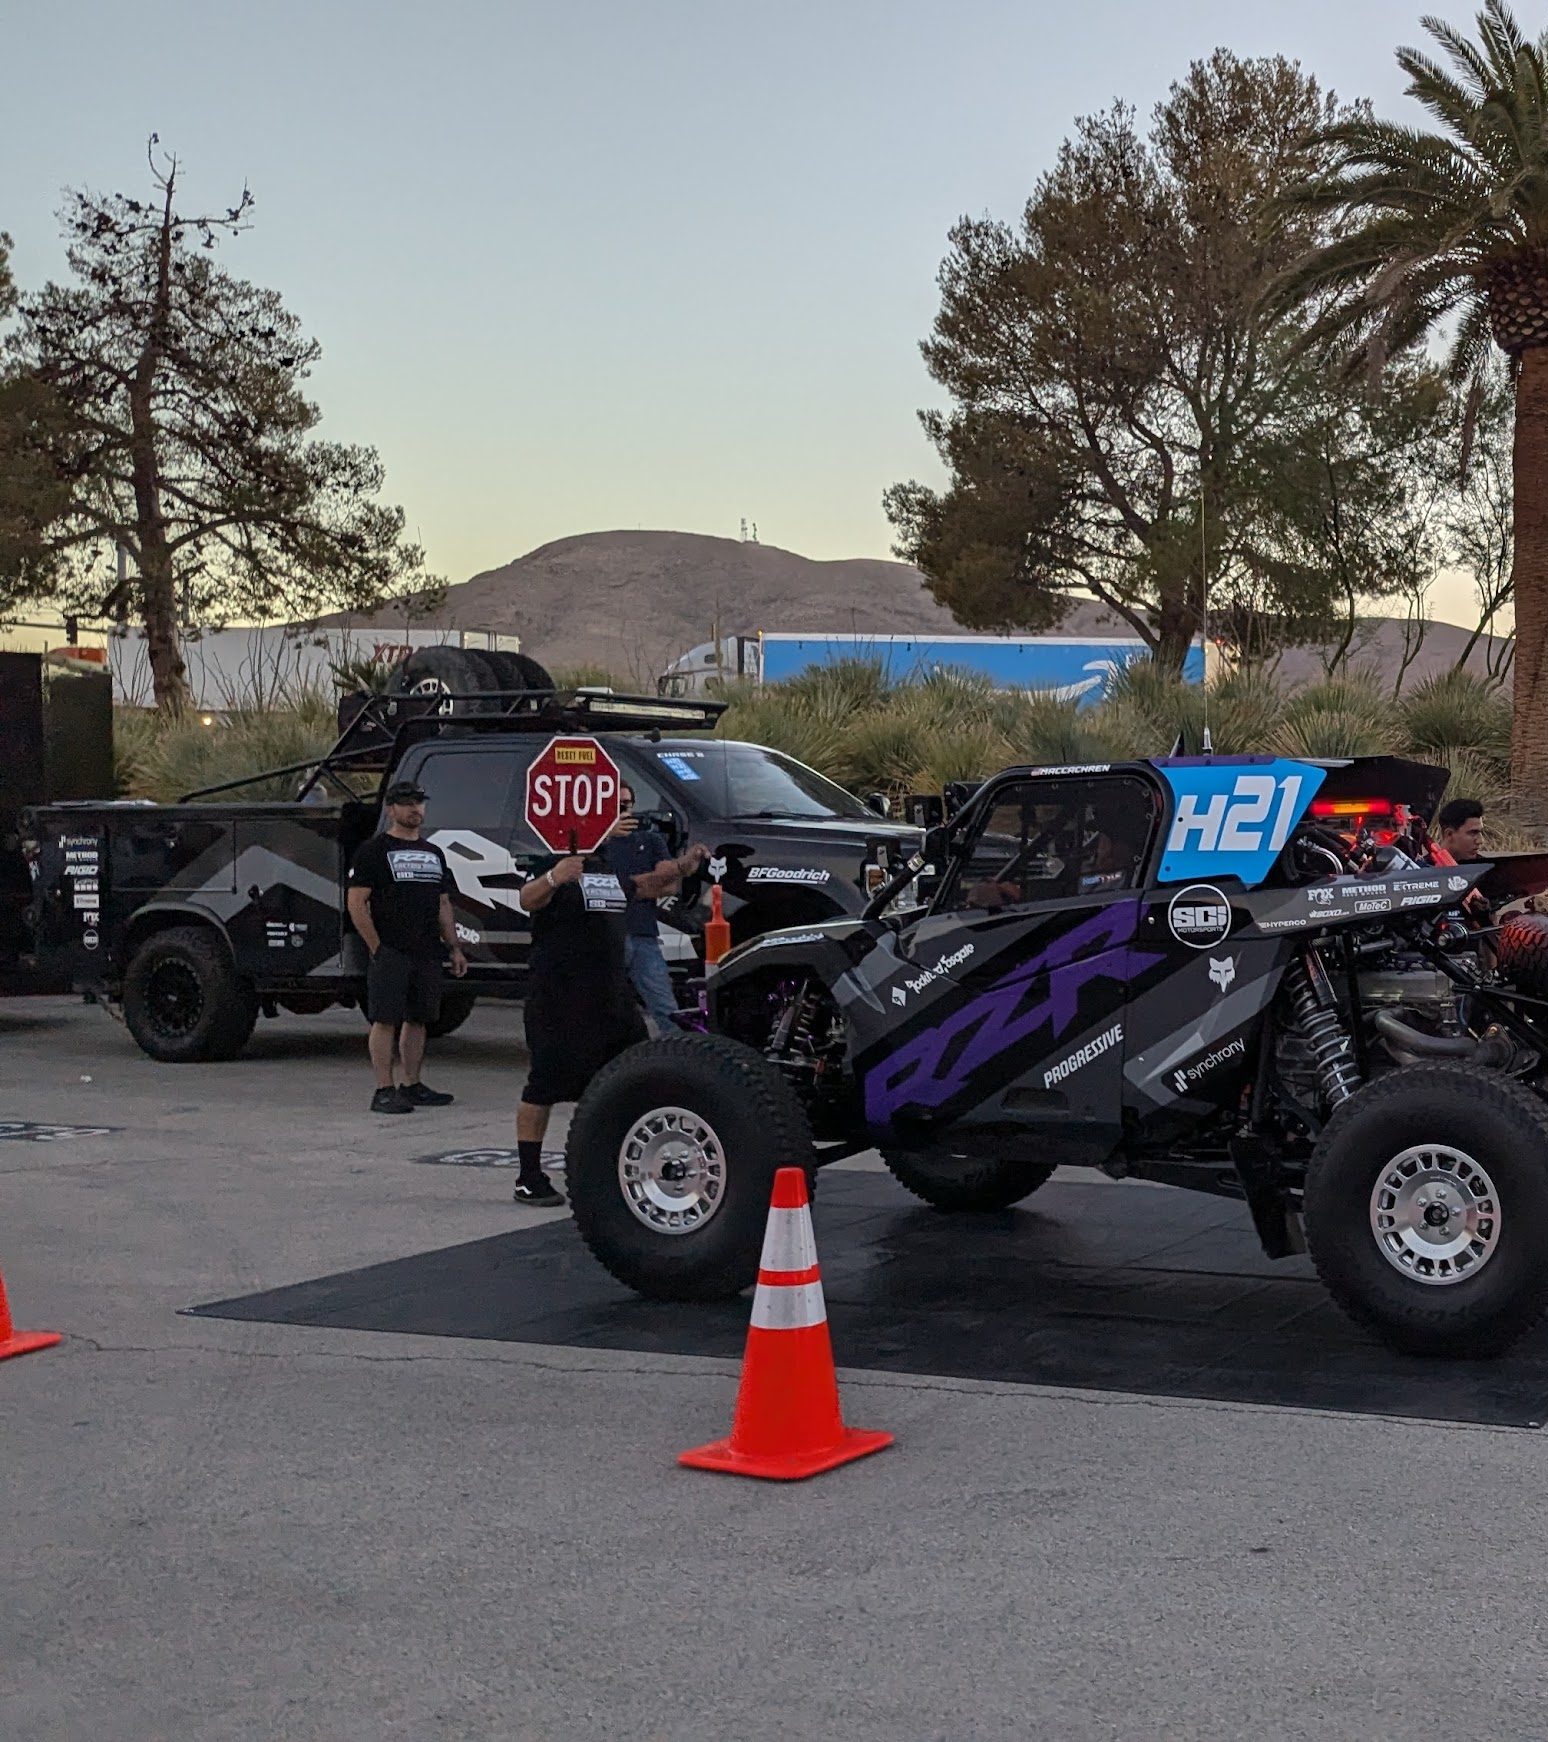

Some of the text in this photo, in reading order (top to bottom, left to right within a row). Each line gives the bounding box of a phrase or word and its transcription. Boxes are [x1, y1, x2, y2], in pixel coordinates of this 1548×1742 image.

[579, 751, 594, 760] FUEL
[532, 774, 615, 817] STOP
[1168, 775, 1303, 851] H21
[748, 867, 830, 881] BFGoodrich
[1307, 887, 1335, 905] FOX
[1342, 885, 1386, 894] METHOD
[1359, 901, 1388, 911] MoTeC
[1401, 895, 1442, 906] RIGID
[864, 899, 1168, 1124] RZR
[1044, 1024, 1124, 1089] PROGRESSIVE
[1187, 1038, 1246, 1080] synchrony
